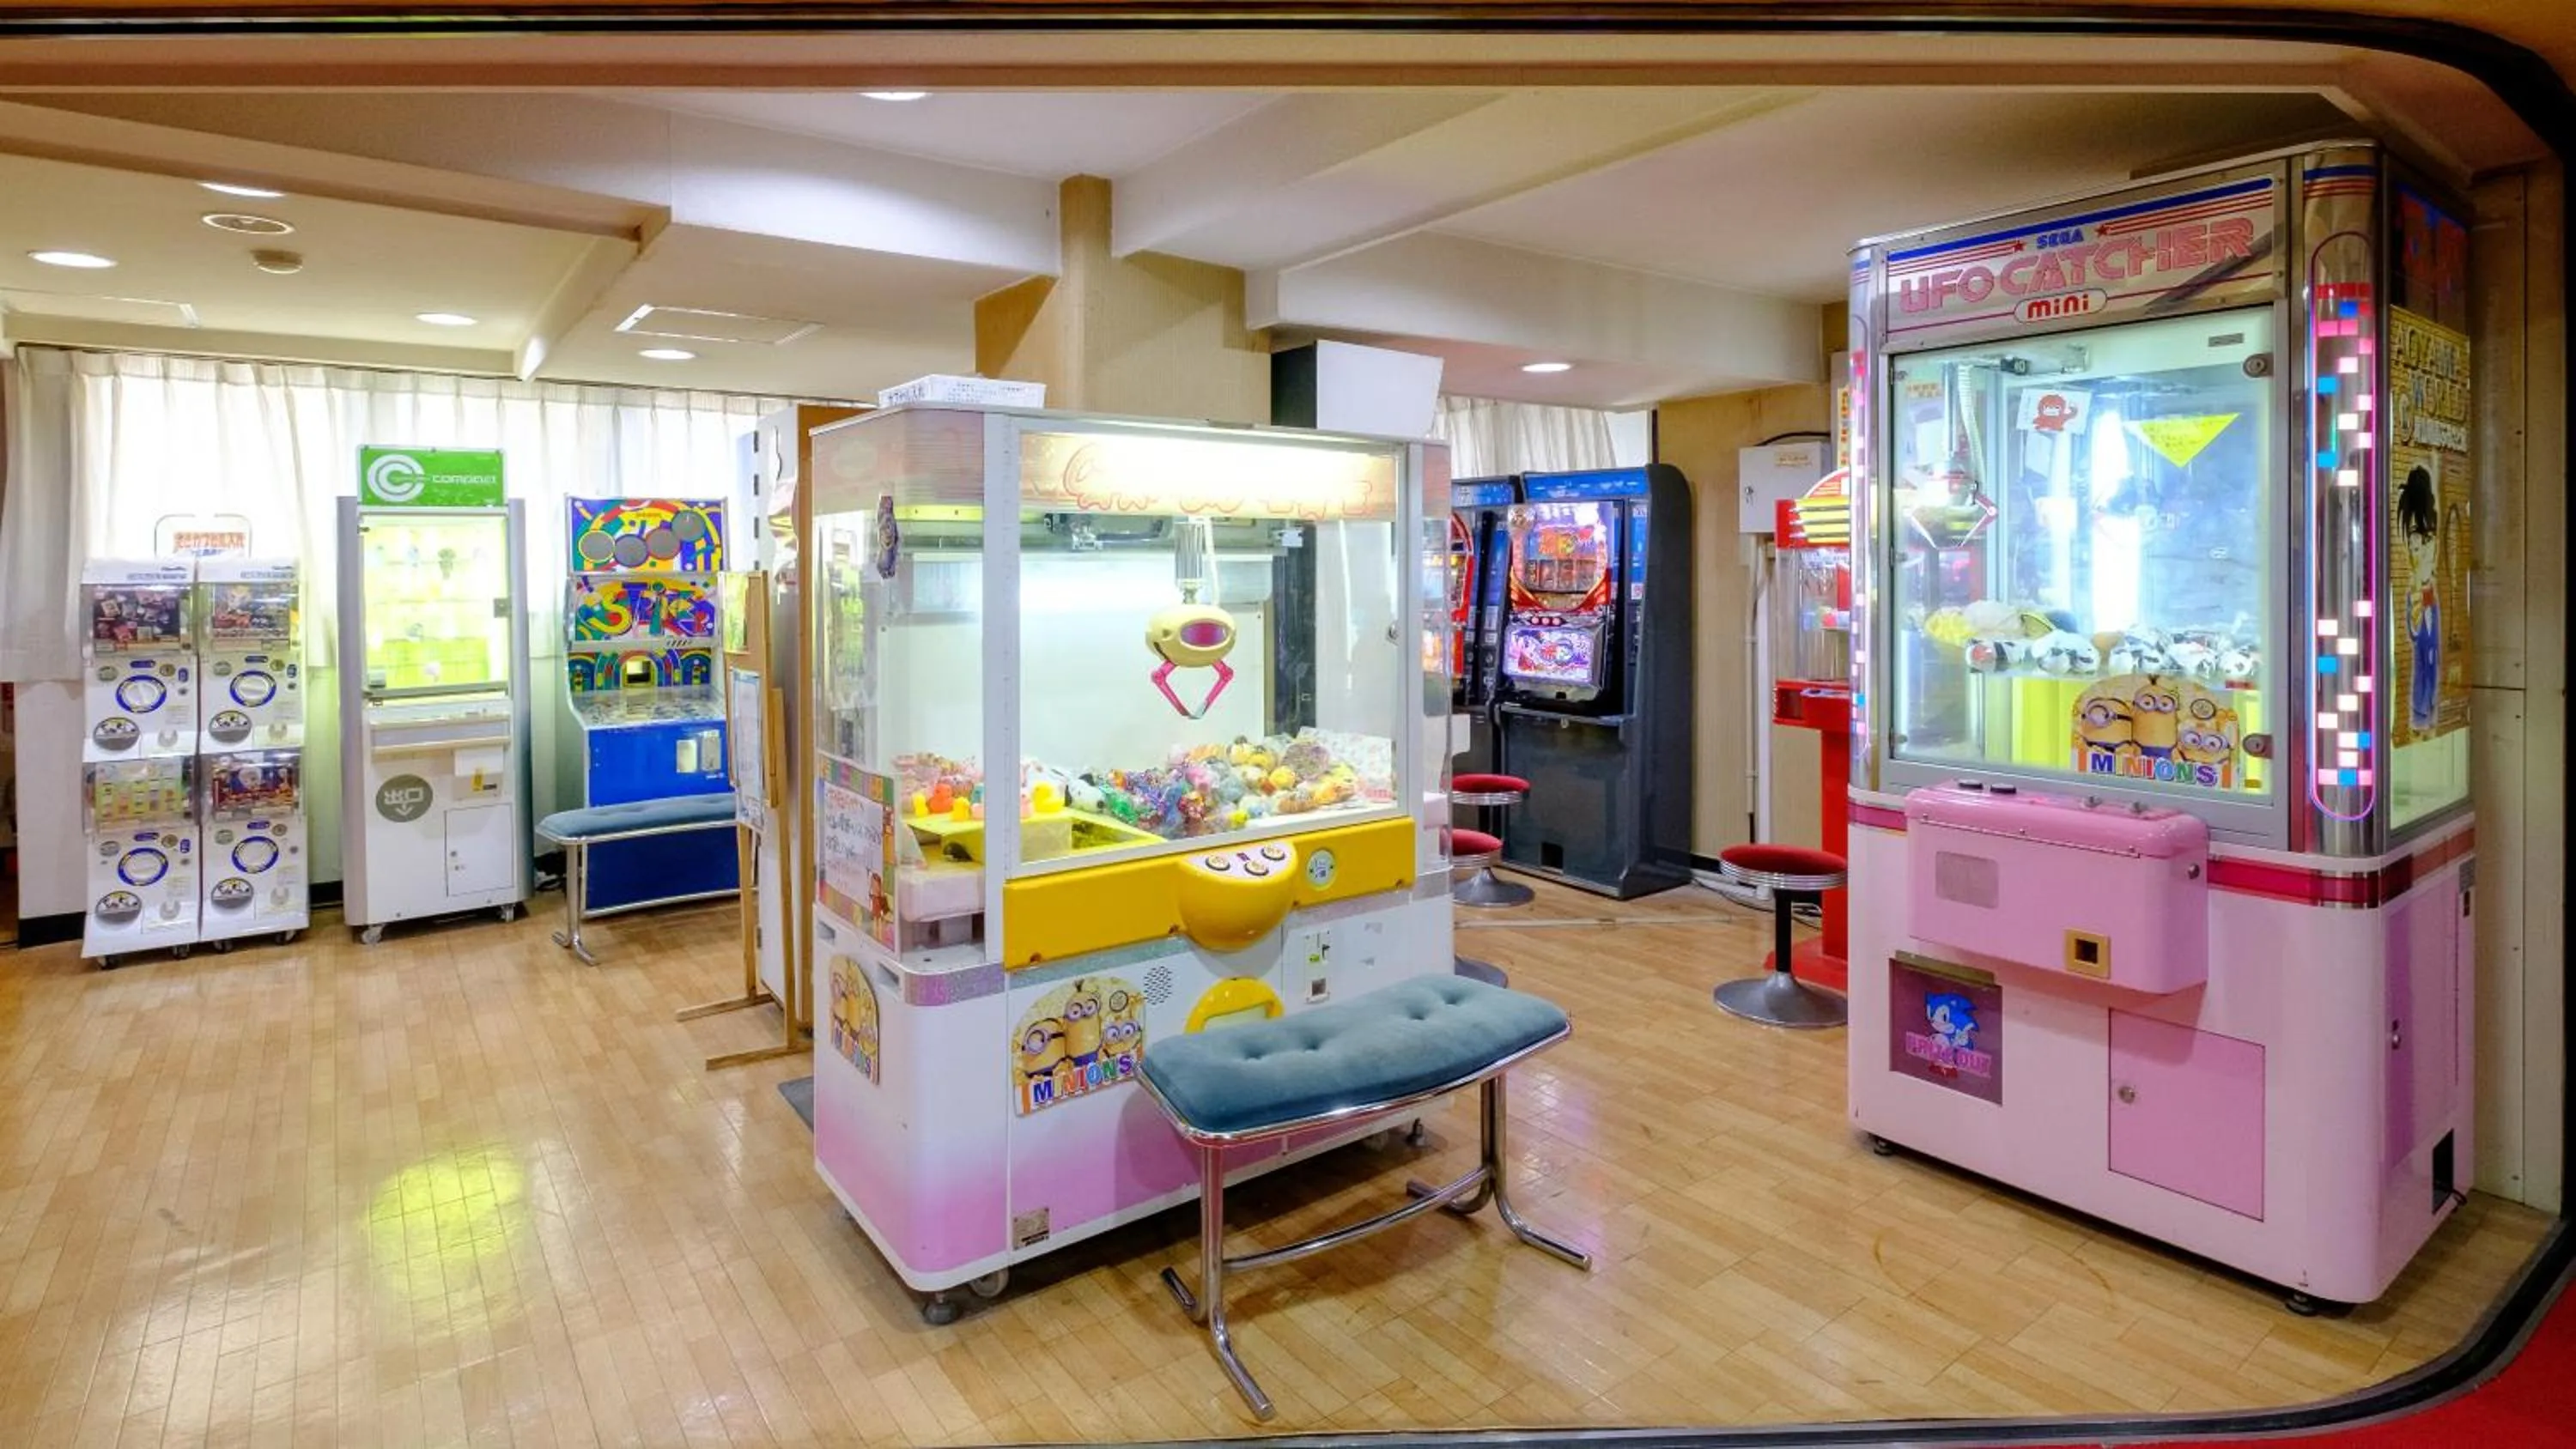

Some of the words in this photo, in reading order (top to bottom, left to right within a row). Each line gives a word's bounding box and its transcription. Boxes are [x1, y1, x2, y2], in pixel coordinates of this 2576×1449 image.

[2036, 227, 2084, 250] SEGA
[1899, 265, 1995, 313] UFO
[2000, 217, 2254, 295] CATCHER
[2026, 288, 2090, 319] mini
[2090, 752, 2219, 787] MINIONS
[384, 787, 424, 805] 出口
[1031, 1054, 1133, 1105] MINIONS
